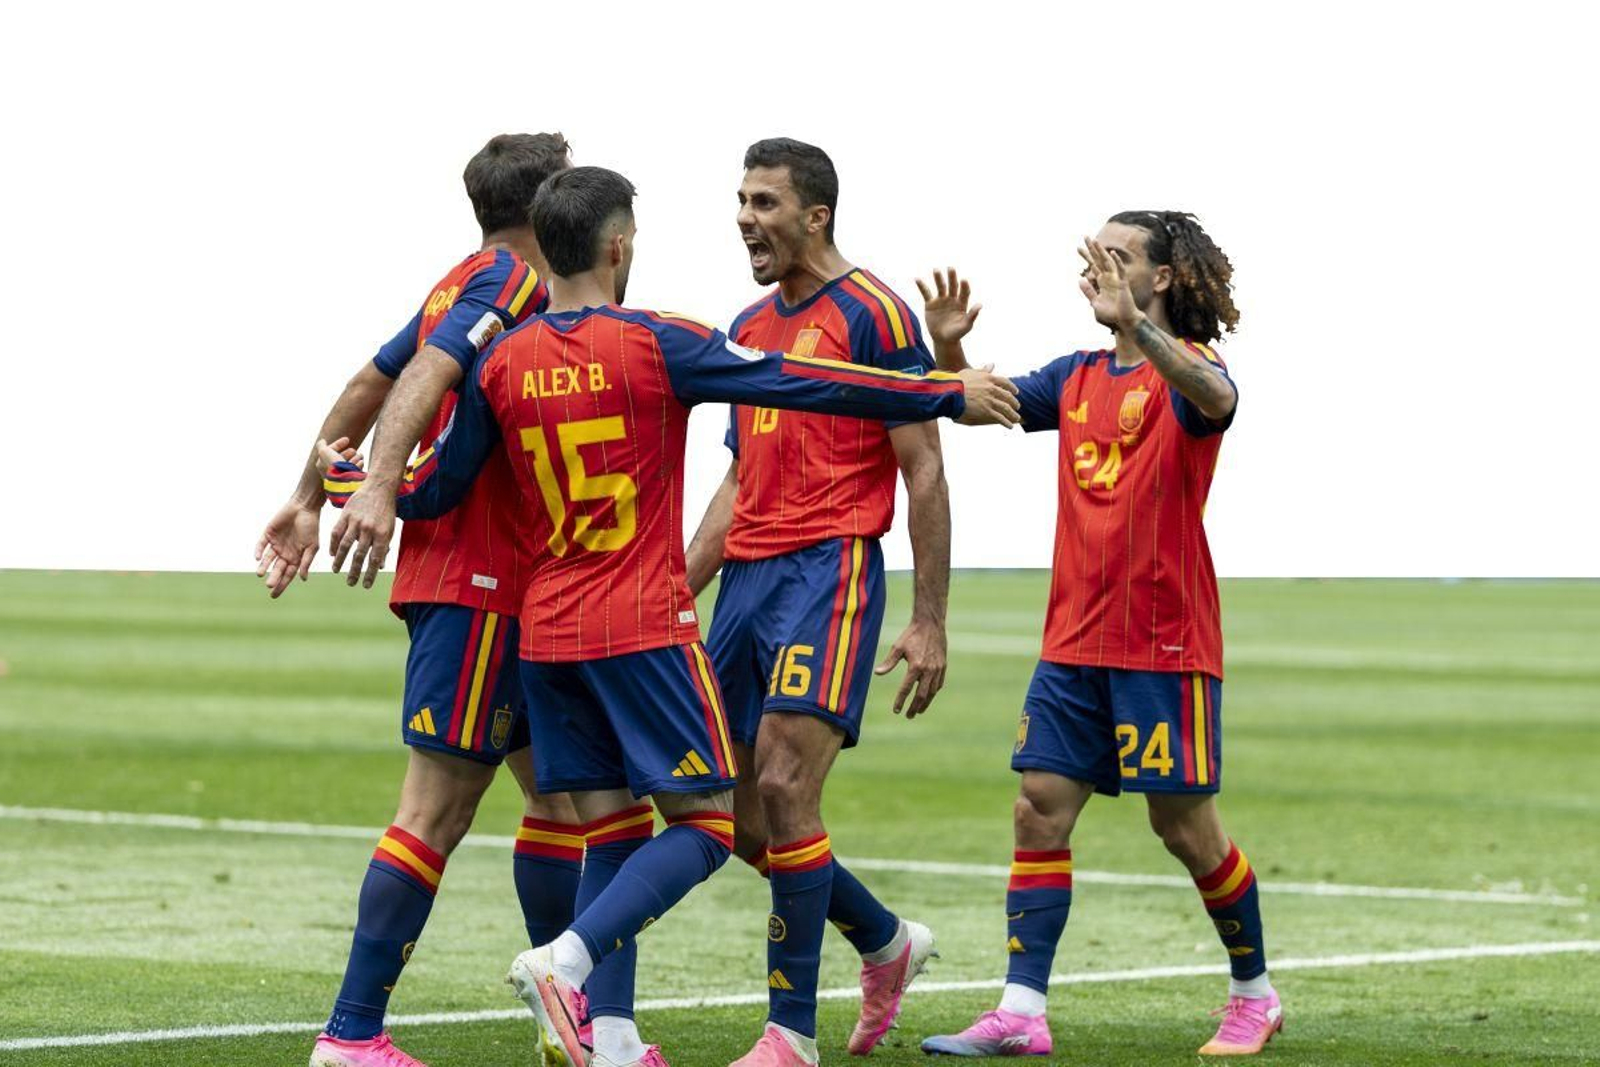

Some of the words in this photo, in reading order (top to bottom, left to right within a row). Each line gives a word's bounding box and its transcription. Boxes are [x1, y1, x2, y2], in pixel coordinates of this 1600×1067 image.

[522, 365, 582, 400] ALEX
[588, 362, 613, 392] B.
[520, 415, 638, 558] 15
[1074, 440, 1122, 491] 24
[769, 644, 814, 697] 16
[1115, 721, 1174, 778] 24
